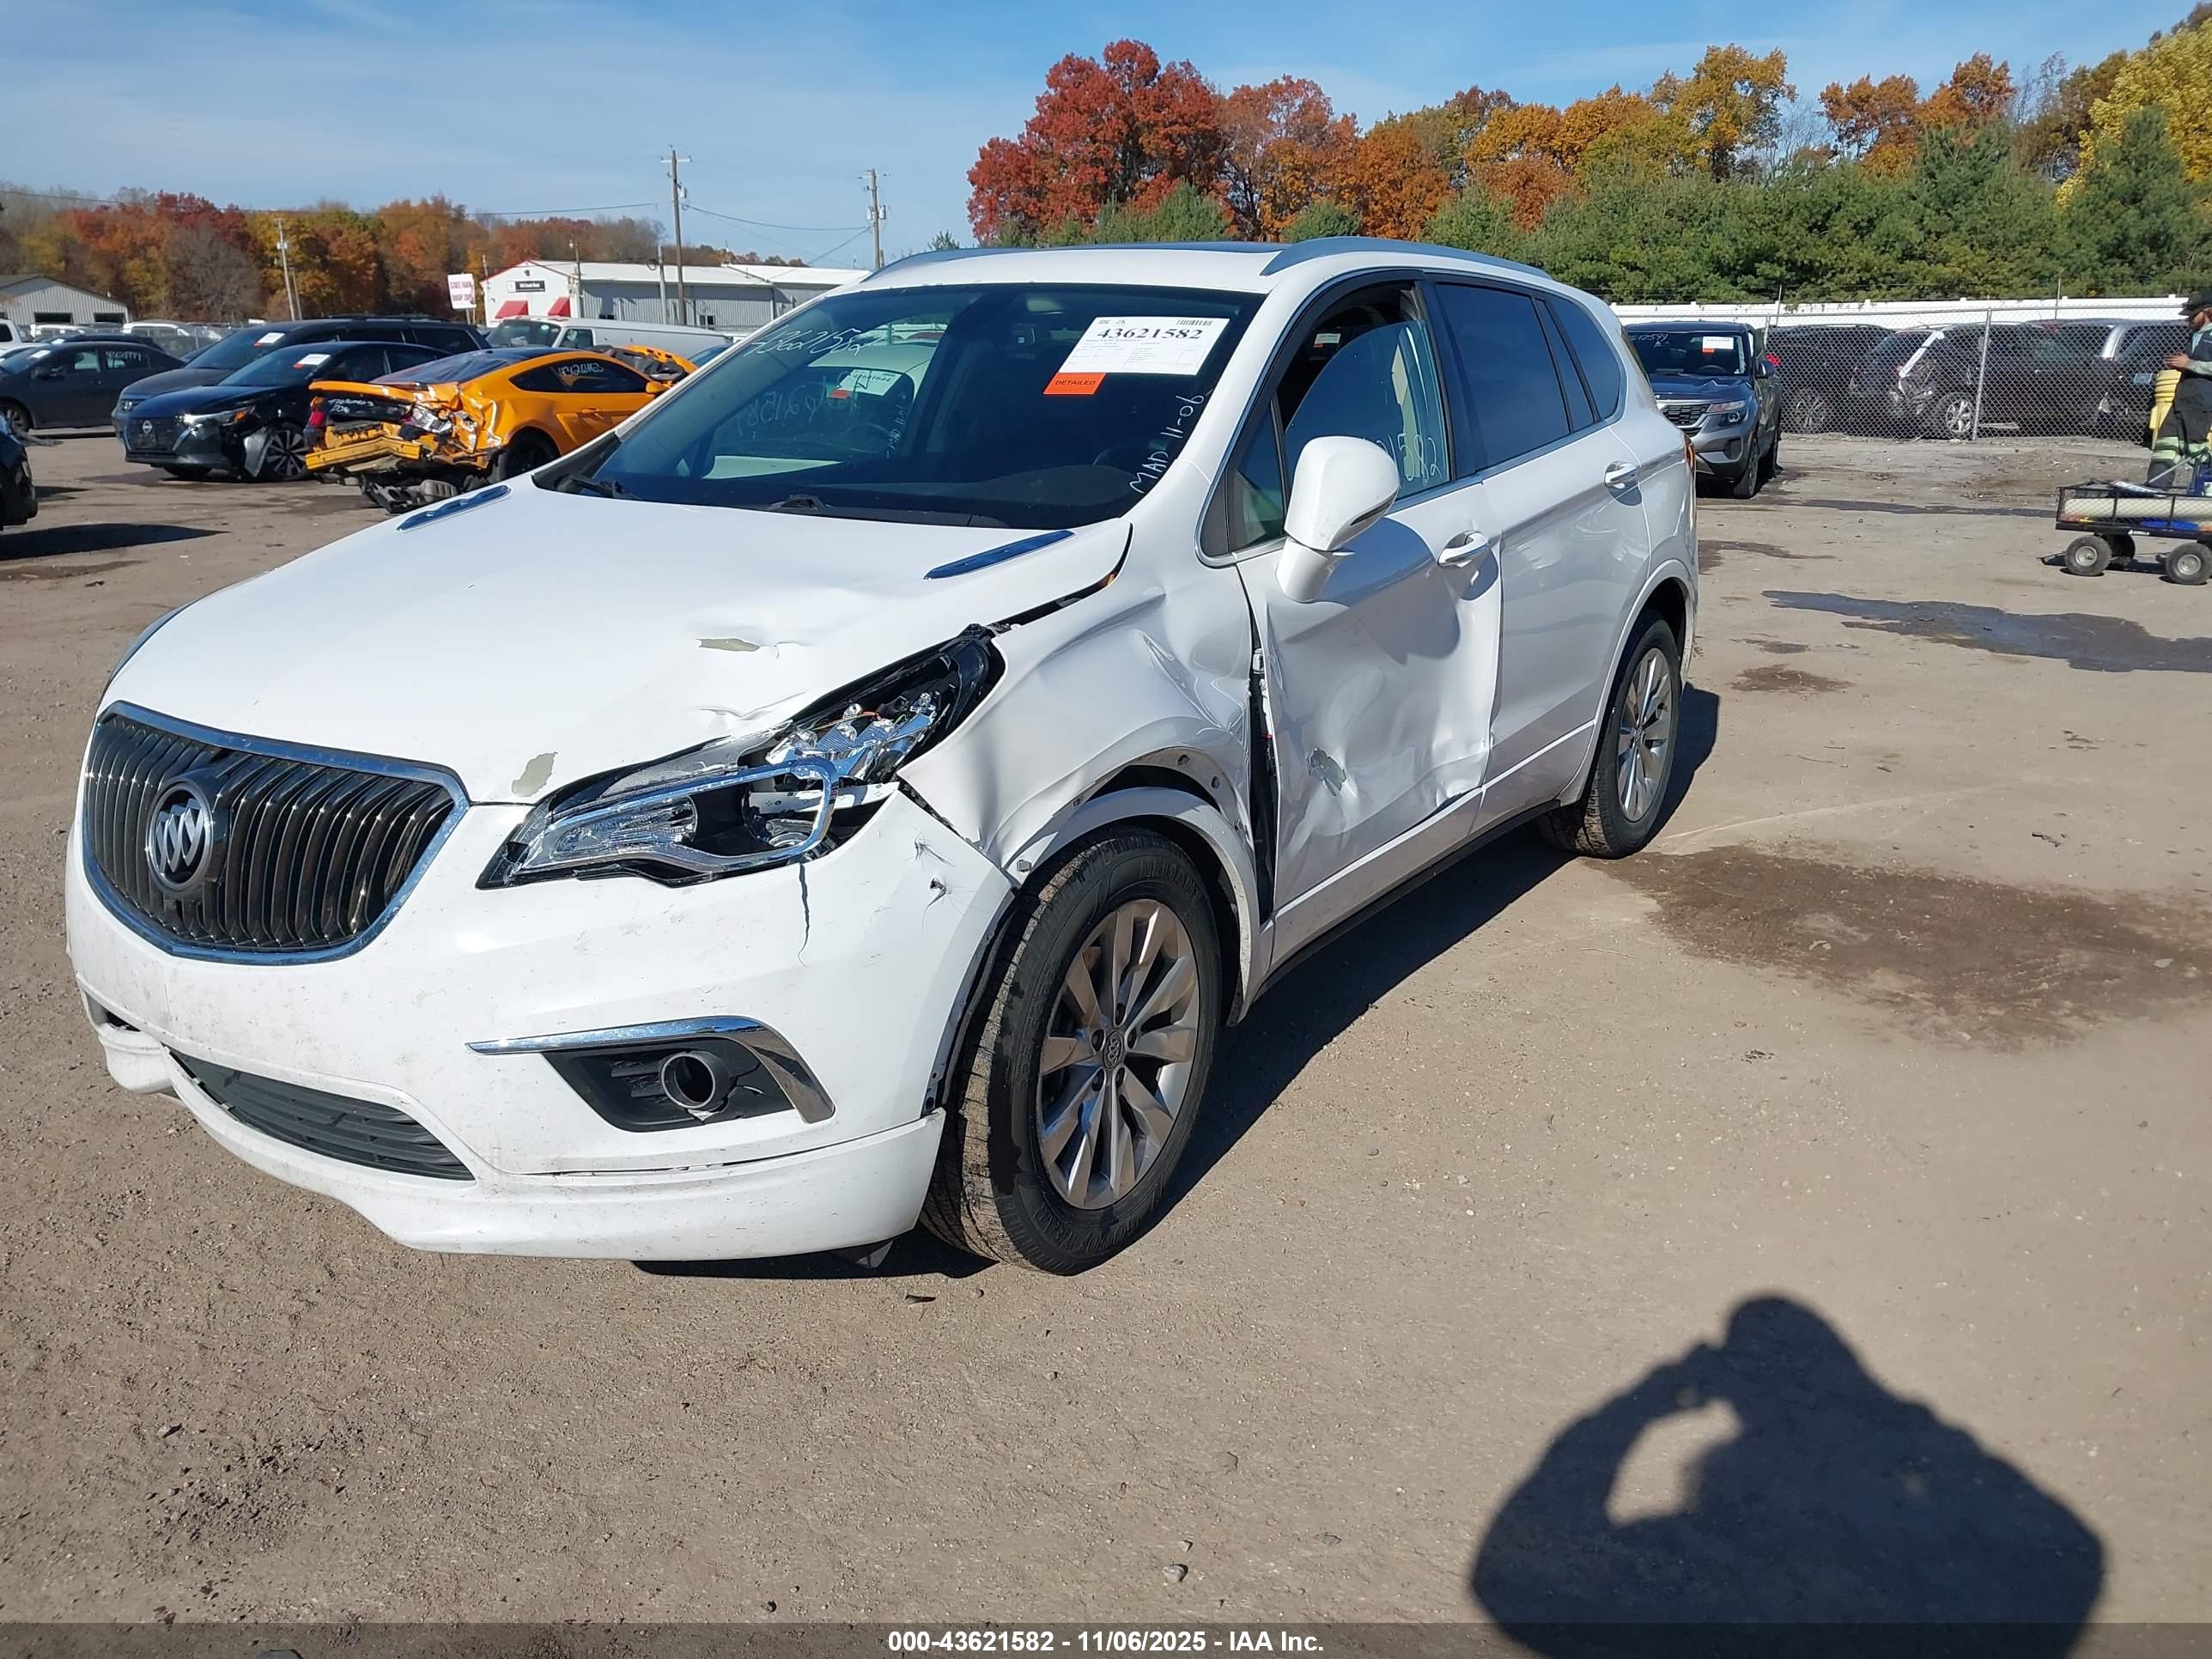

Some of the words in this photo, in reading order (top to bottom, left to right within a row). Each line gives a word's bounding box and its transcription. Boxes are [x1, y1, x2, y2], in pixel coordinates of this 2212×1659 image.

[1097, 328, 1203, 339] 43621582
[1129, 451, 1169, 494] MAD
[1160, 395, 1205, 439] 11-06
